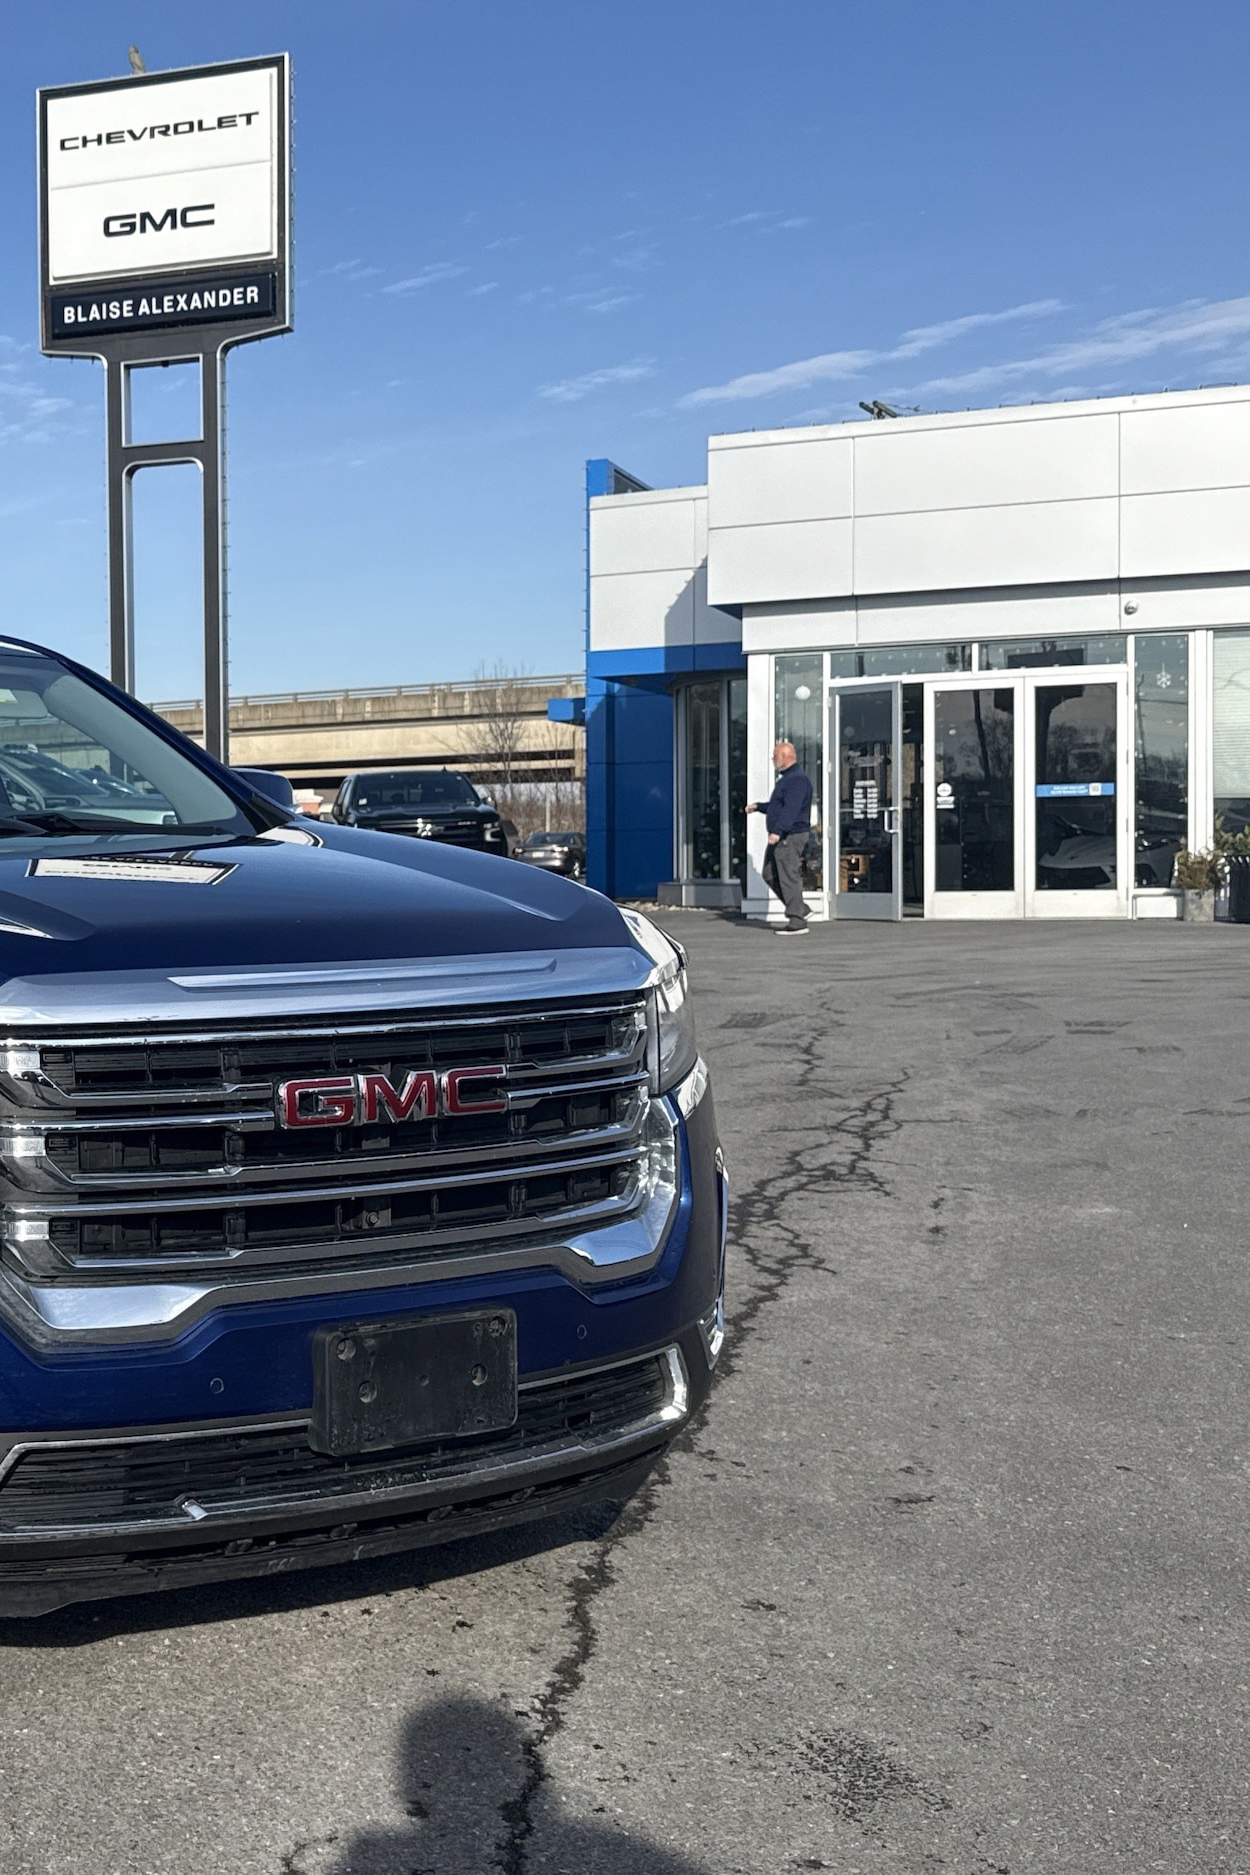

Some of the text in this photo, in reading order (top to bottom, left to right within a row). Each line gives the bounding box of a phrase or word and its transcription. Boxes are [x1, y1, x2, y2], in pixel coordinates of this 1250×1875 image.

[60, 111, 260, 151] CHEVROLET
[103, 203, 216, 238] GMC
[63, 285, 259, 324] BLAISE ALEXANDER
[278, 1064, 507, 1130] GMC
